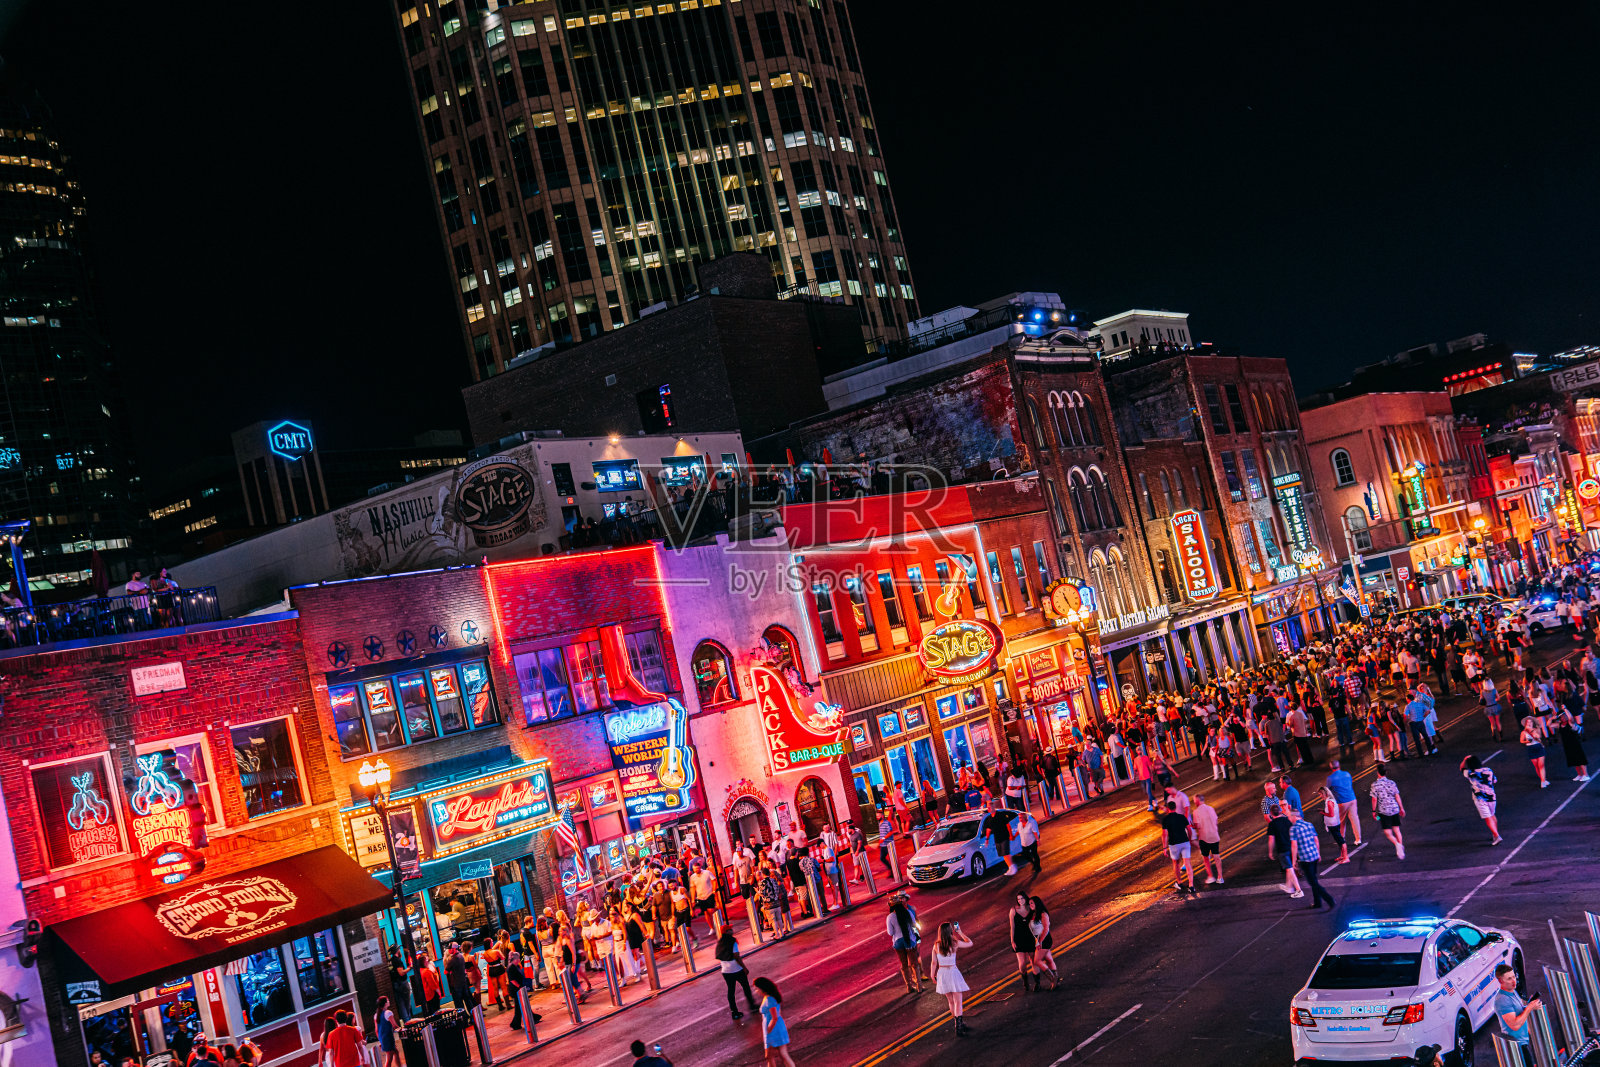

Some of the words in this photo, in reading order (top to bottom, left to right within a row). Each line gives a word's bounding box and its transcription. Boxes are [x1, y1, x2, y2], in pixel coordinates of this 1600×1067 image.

[1564, 366, 1597, 378] OLE
[1564, 372, 1599, 386] RED
[274, 432, 305, 449] CMT
[482, 470, 497, 482] THE
[460, 474, 531, 523] STAGE
[367, 496, 436, 536] NASHVILLE
[1174, 514, 1198, 526] LUCKY
[1284, 487, 1307, 550] WHISKEY
[490, 521, 530, 544] BROADWAY
[377, 525, 425, 563] Music
[1181, 523, 1208, 590] SALOON
[1046, 580, 1060, 592] BIG
[1060, 577, 1081, 586] TIME
[1190, 586, 1217, 597] BASTARD
[945, 623, 960, 633] THE
[1097, 618, 1119, 635] LUCKY
[1119, 610, 1146, 630] BASTARD
[1146, 604, 1169, 621] SALOON
[922, 630, 995, 668] STAGE
[142, 666, 181, 679] FRIEDMAN
[951, 667, 989, 684] BROADWAY
[1032, 681, 1060, 701] BOOTS
[1063, 674, 1085, 691] HATS
[611, 706, 666, 744] Robert's
[758, 674, 790, 770] JACKS
[612, 737, 668, 755] WESTERN
[790, 743, 845, 763] BAR-B-QUE
[622, 749, 662, 764] WORLD
[619, 764, 652, 778] HOME
[442, 781, 545, 836] Layla's
[133, 809, 190, 838] SECOND
[138, 828, 191, 857] FIDDLE
[463, 863, 490, 876] Layla's
[206, 889, 222, 897] THE
[166, 897, 227, 934] SECOND
[222, 881, 290, 907] FIDDLE
[225, 920, 288, 943] NASHVILLE
[1312, 1007, 1344, 1015] METRO
[1351, 1005, 1389, 1015] POLICE
